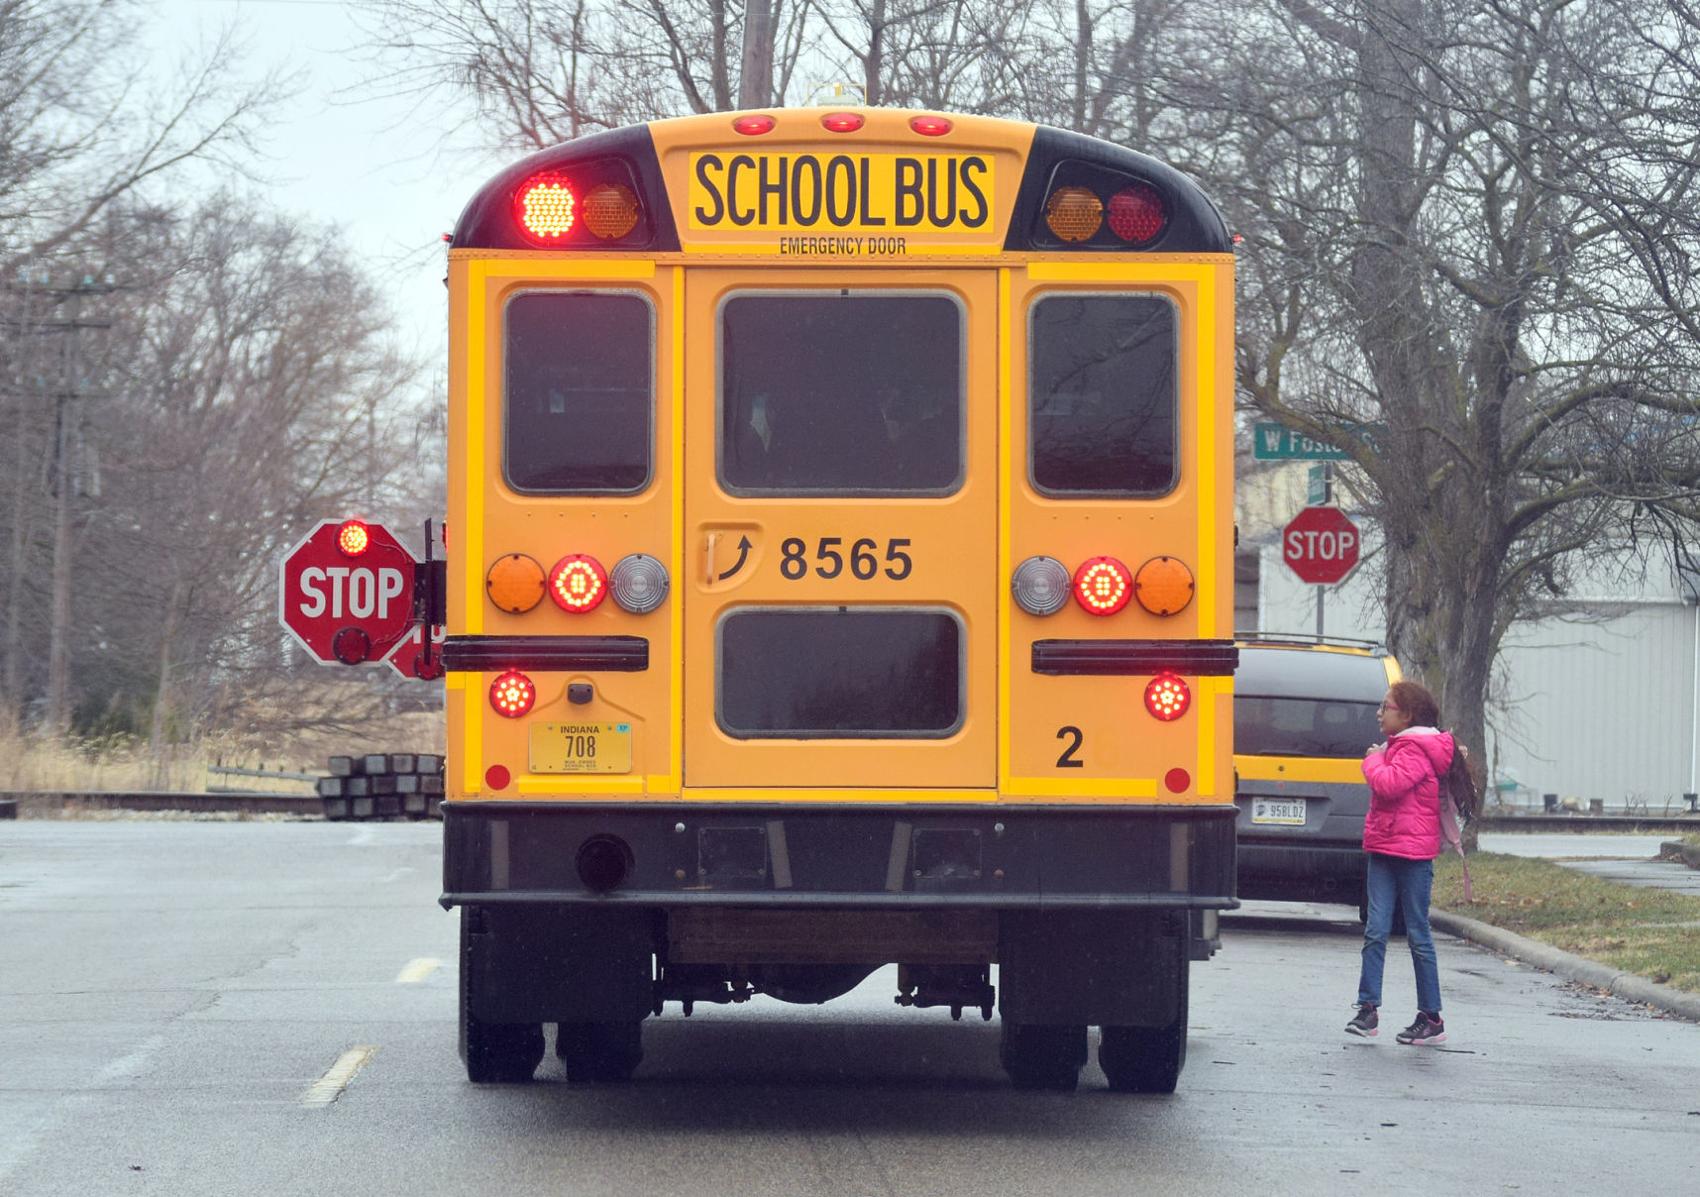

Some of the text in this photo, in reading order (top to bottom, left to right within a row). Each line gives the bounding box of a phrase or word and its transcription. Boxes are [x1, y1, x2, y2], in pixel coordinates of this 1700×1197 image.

[695, 154, 988, 228] SCHOOL BUS
[780, 237, 906, 255] EMERGENCY DOOR
[1264, 430, 1281, 452] W
[1290, 431, 1350, 453] Fos
[780, 537, 912, 581] 8565
[1287, 531, 1355, 560] STOP
[300, 566, 404, 619] STOP
[560, 726, 600, 734] INDIANA
[565, 735, 596, 758] 708
[1056, 726, 1083, 768] 2
